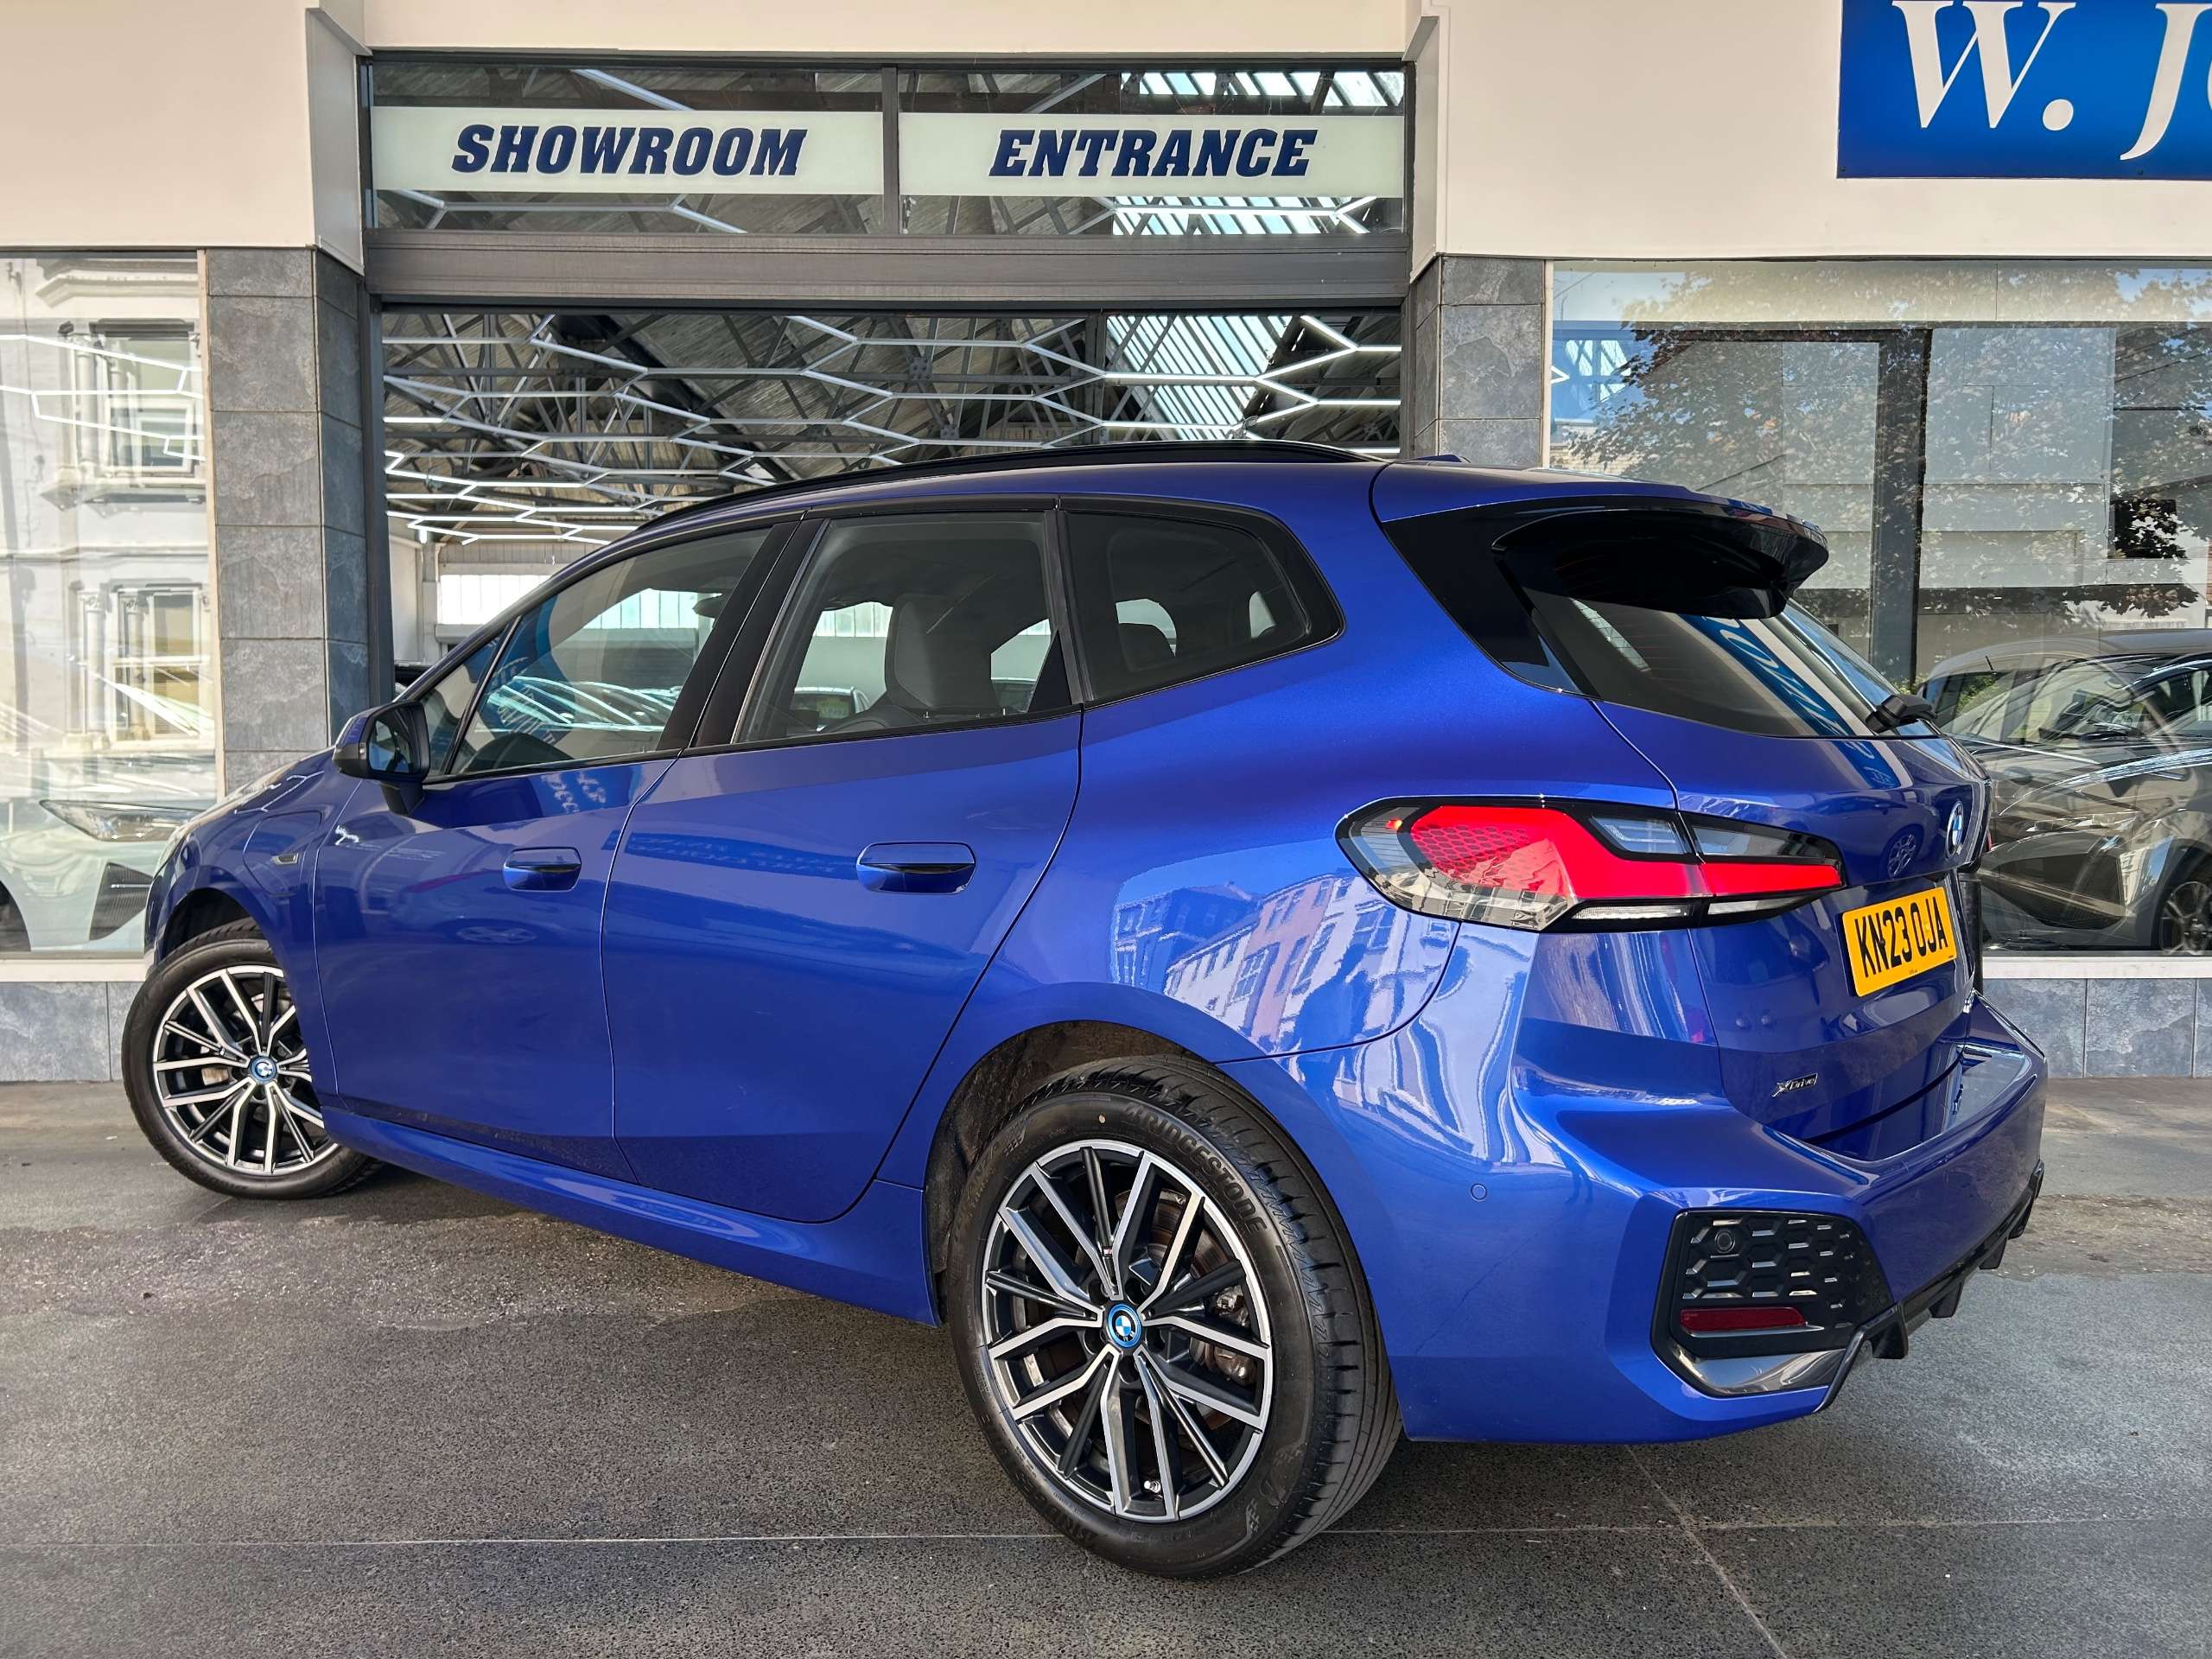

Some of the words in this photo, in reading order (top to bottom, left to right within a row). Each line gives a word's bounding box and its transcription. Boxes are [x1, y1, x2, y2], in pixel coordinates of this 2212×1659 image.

[1892, 1, 2075, 131] W.
[2120, 3, 2212, 161] J
[452, 124, 807, 175] SHOWROOM
[988, 129, 1318, 177] ENTRANCE
[1854, 906, 1912, 978] KN23
[1910, 896, 1948, 957] OJA
